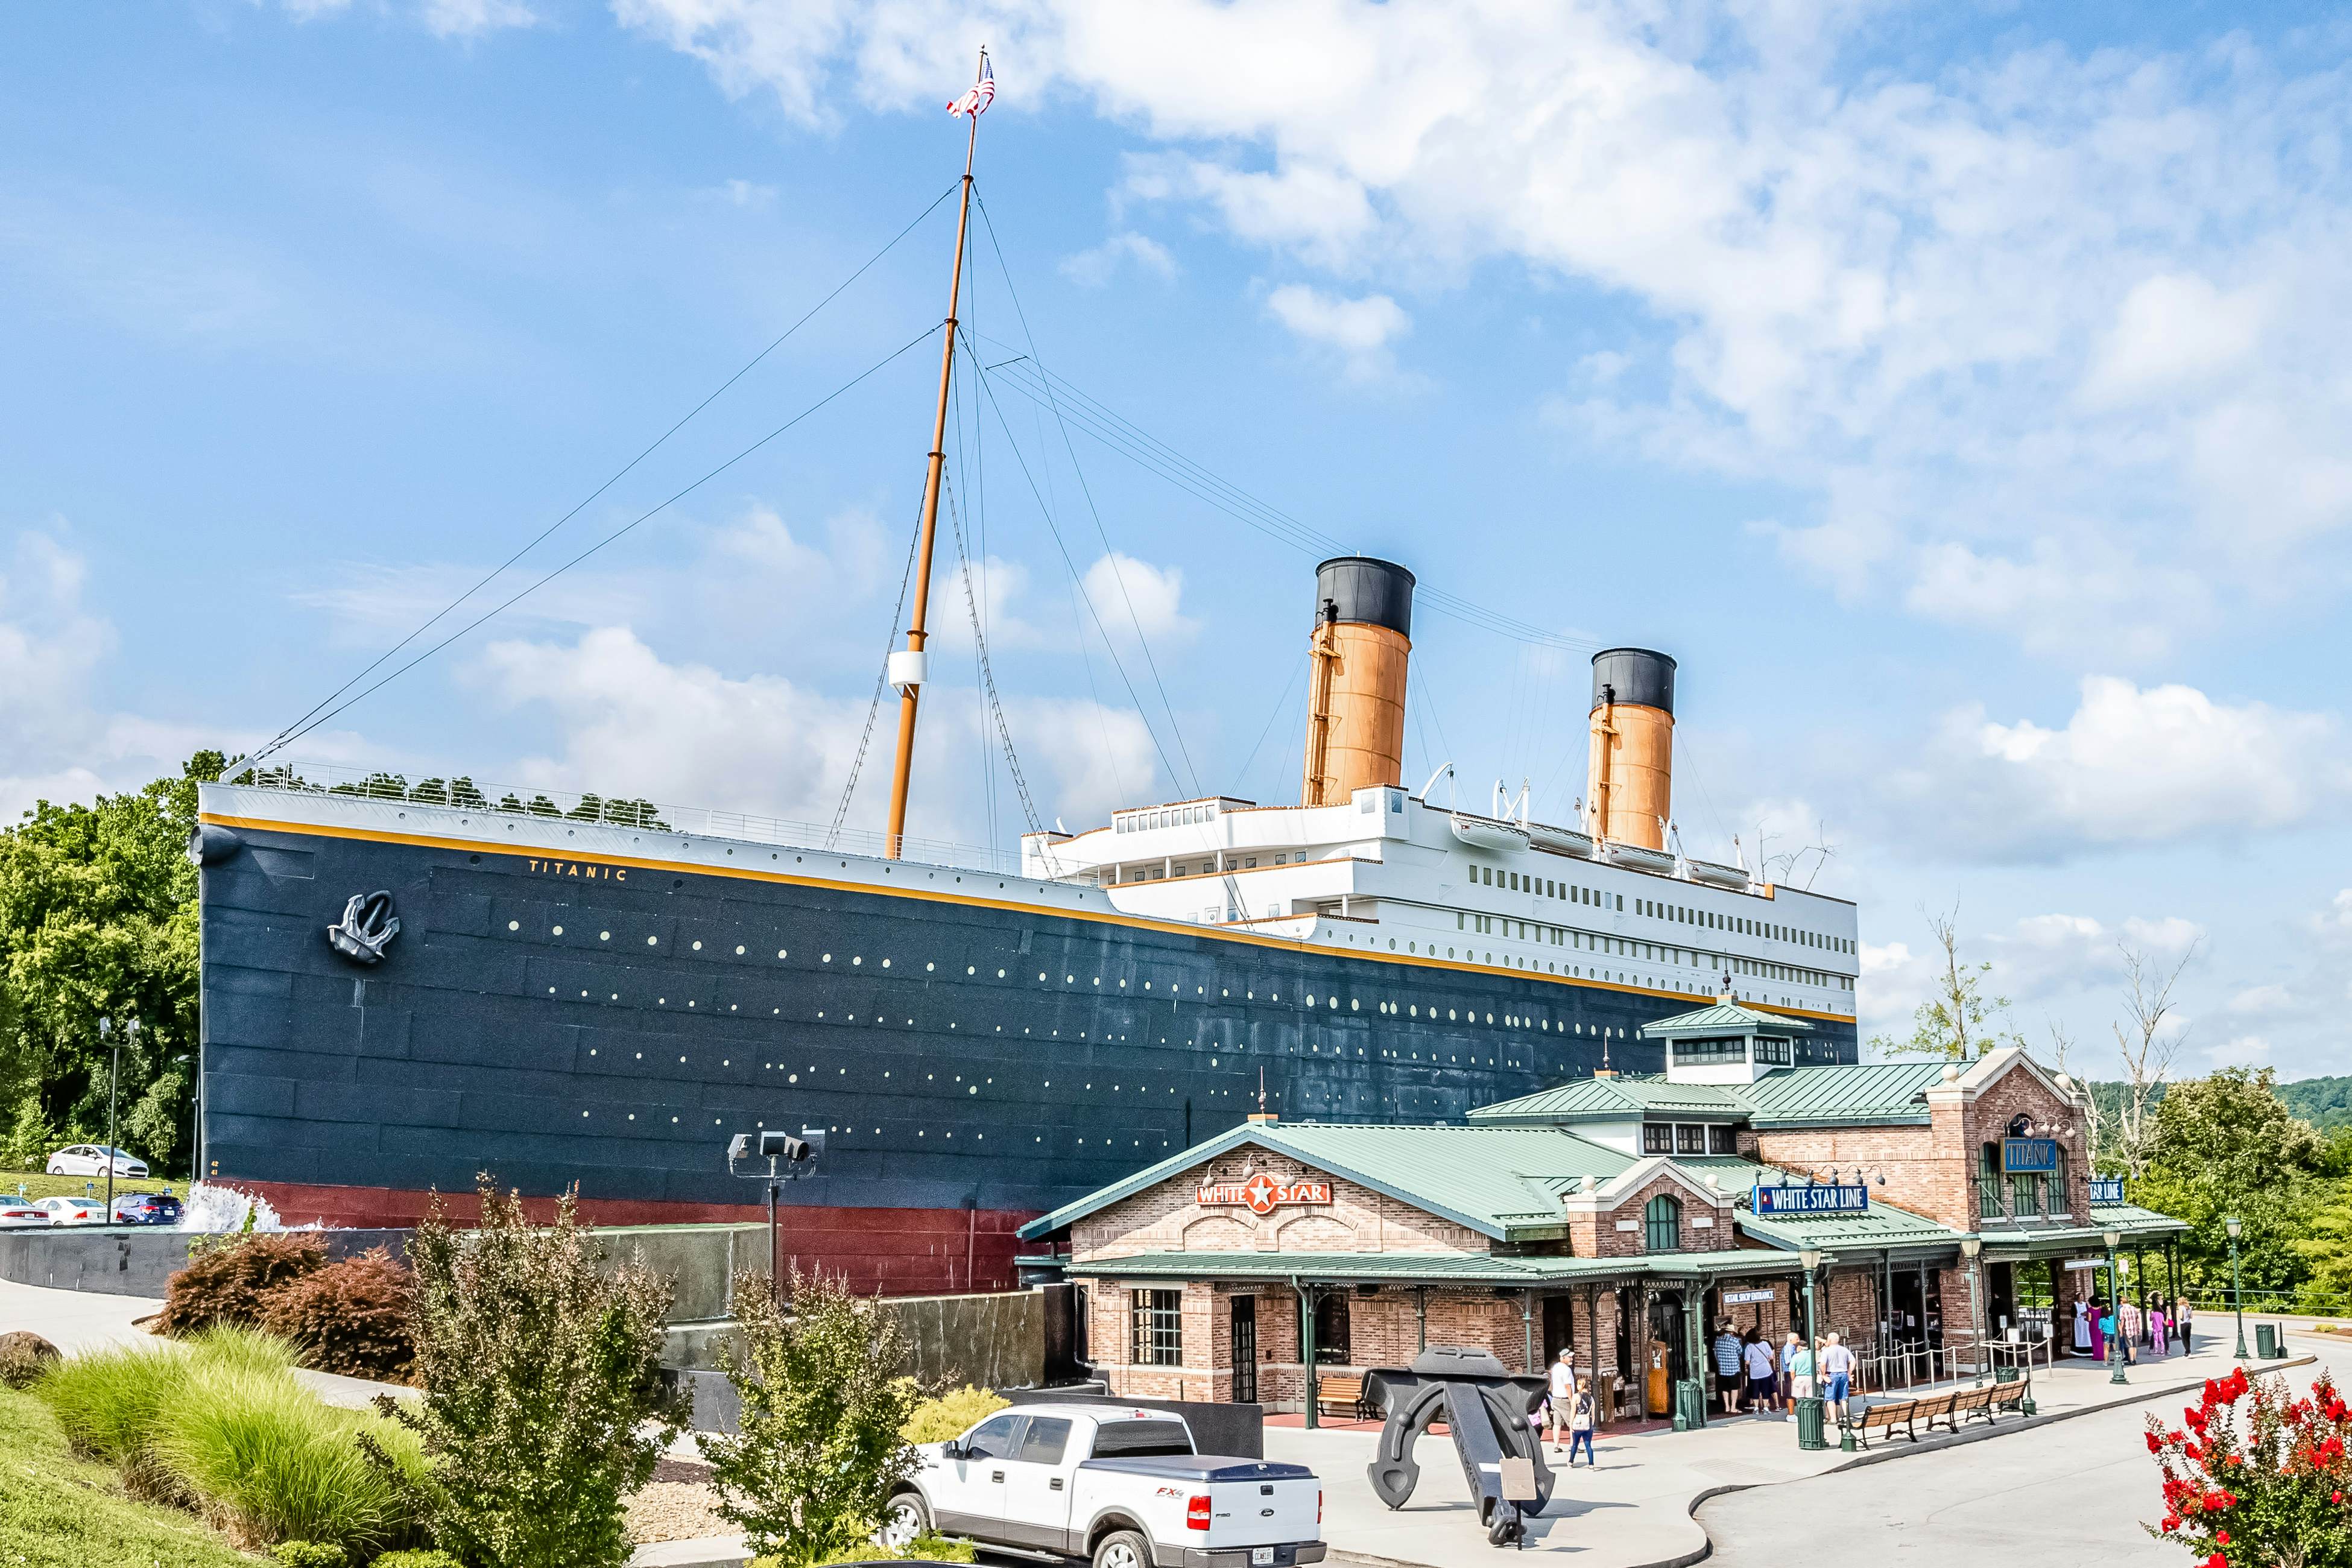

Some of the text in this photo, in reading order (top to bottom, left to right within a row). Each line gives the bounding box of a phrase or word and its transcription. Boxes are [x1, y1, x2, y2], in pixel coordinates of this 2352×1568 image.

[529, 860, 627, 881] TITANIC
[2006, 1143, 2054, 1166] TITANIC
[1199, 1185, 1323, 1203] WHITE STAR
[1771, 1187, 1864, 1210] WHITE STAR LINE
[2088, 1183, 2120, 1200] TAR LINE
[1739, 1292, 1751, 1302] SHOP
[1751, 1291, 1774, 1301] ENTRANCE
[1156, 1487, 1184, 1497] FX4
